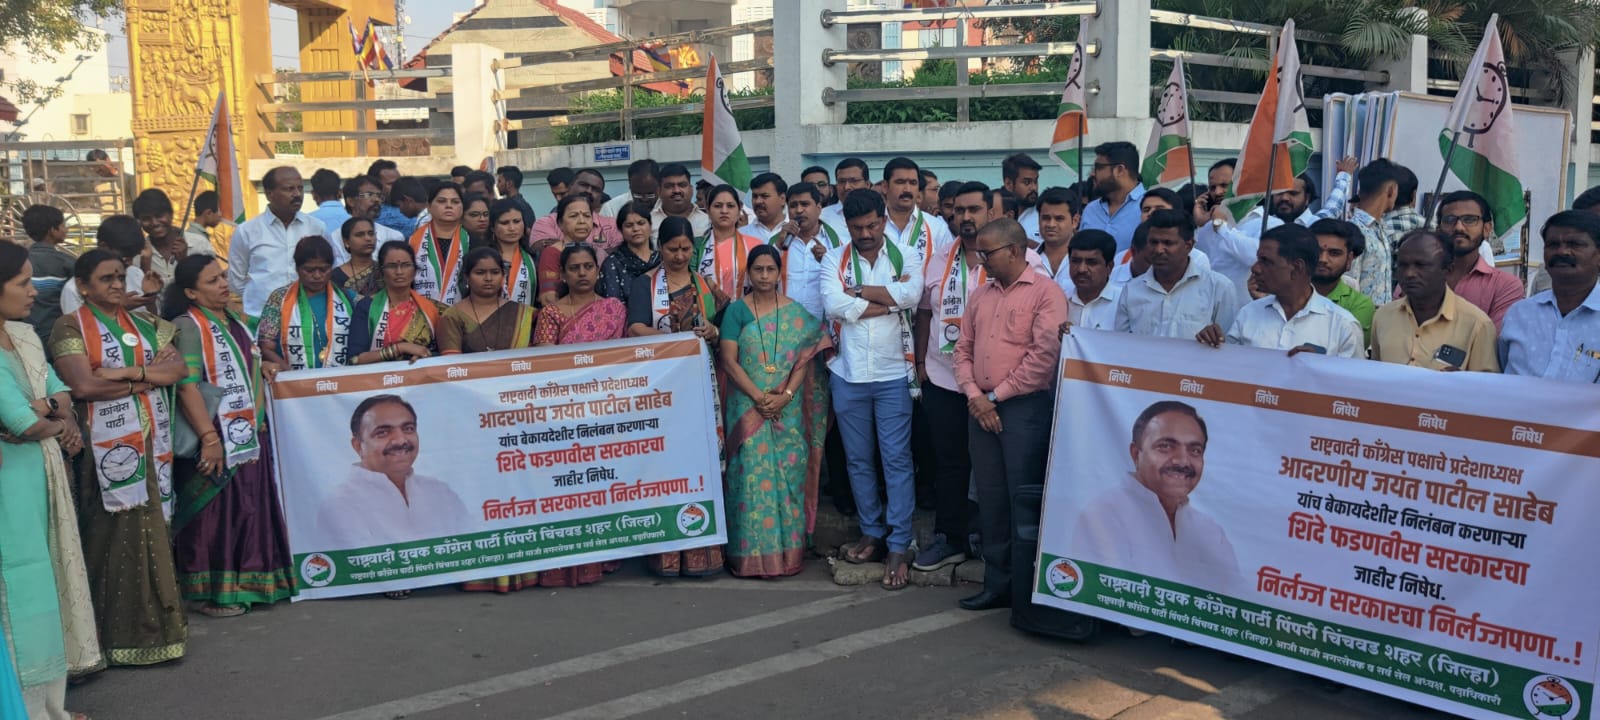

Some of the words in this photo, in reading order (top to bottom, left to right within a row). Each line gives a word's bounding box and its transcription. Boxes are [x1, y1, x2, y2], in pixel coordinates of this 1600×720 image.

[316, 380, 338, 392] निषेध
[383, 374, 404, 386] निषेध
[446, 367, 468, 378] निषेध
[511, 360, 531, 372] निषेध
[573, 354, 593, 365] निषेध
[635, 347, 655, 358] निषेध
[498, 385, 537, 404] राष्ट्रवादी
[572, 379, 600, 395] पक्षाचे
[601, 375, 649, 393] प्रदेशाध्यक्ष
[479, 403, 547, 429] आदरणीय
[549, 399, 585, 420] जयंत
[588, 394, 631, 415] पाटील
[634, 388, 672, 411] साहेब
[1109, 369, 1132, 384] निषेध
[1180, 378, 1205, 395] निषेध
[1255, 389, 1279, 405] निषेध
[1333, 401, 1360, 417] निषेध
[1418, 413, 1448, 430] निषेध
[1512, 426, 1544, 444] निषेध
[528, 443, 596, 468] फडणवीस
[598, 436, 664, 459] सरकारचा
[1310, 436, 1360, 458] राष्ट्रवादी
[1407, 451, 1448, 472] पक्षाचे
[1450, 456, 1524, 485] प्रदेशाध्यक्ष
[552, 470, 584, 487] जाहीर
[585, 466, 618, 483] निषेध.
[1279, 456, 1369, 490] आदरणीय
[1371, 470, 1422, 500] जयंत
[1425, 479, 1490, 513] पाटील
[1493, 491, 1558, 525] साहेब
[482, 498, 537, 522] निर्लज्ज
[540, 489, 608, 515] सरकारचा
[347, 548, 395, 567] राष्ट्रवादी
[398, 546, 430, 563] युवक
[474, 533, 500, 549] पार्टी
[503, 529, 537, 546] पिंपरी
[540, 526, 582, 540] चिंचवड
[585, 521, 611, 534] शहर
[616, 512, 661, 531] (जिल्हा)
[1330, 525, 1423, 564] फडणवीस
[1425, 545, 1530, 586] सरकारचा
[1257, 566, 1327, 606] निर्लज्ज
[1330, 588, 1424, 630] सरकारचा
[1354, 566, 1397, 590] जाहीर
[1399, 572, 1445, 600] निषेध.
[1099, 574, 1151, 598] राष्ट्रवादी
[1154, 587, 1190, 606] युवक
[1241, 609, 1272, 628] पार्टी
[1275, 614, 1318, 640] पिंपरी
[1322, 626, 1380, 655] चिंचवड
[1384, 644, 1423, 667] शहर
[1428, 654, 1499, 687] (जिल्हा)
